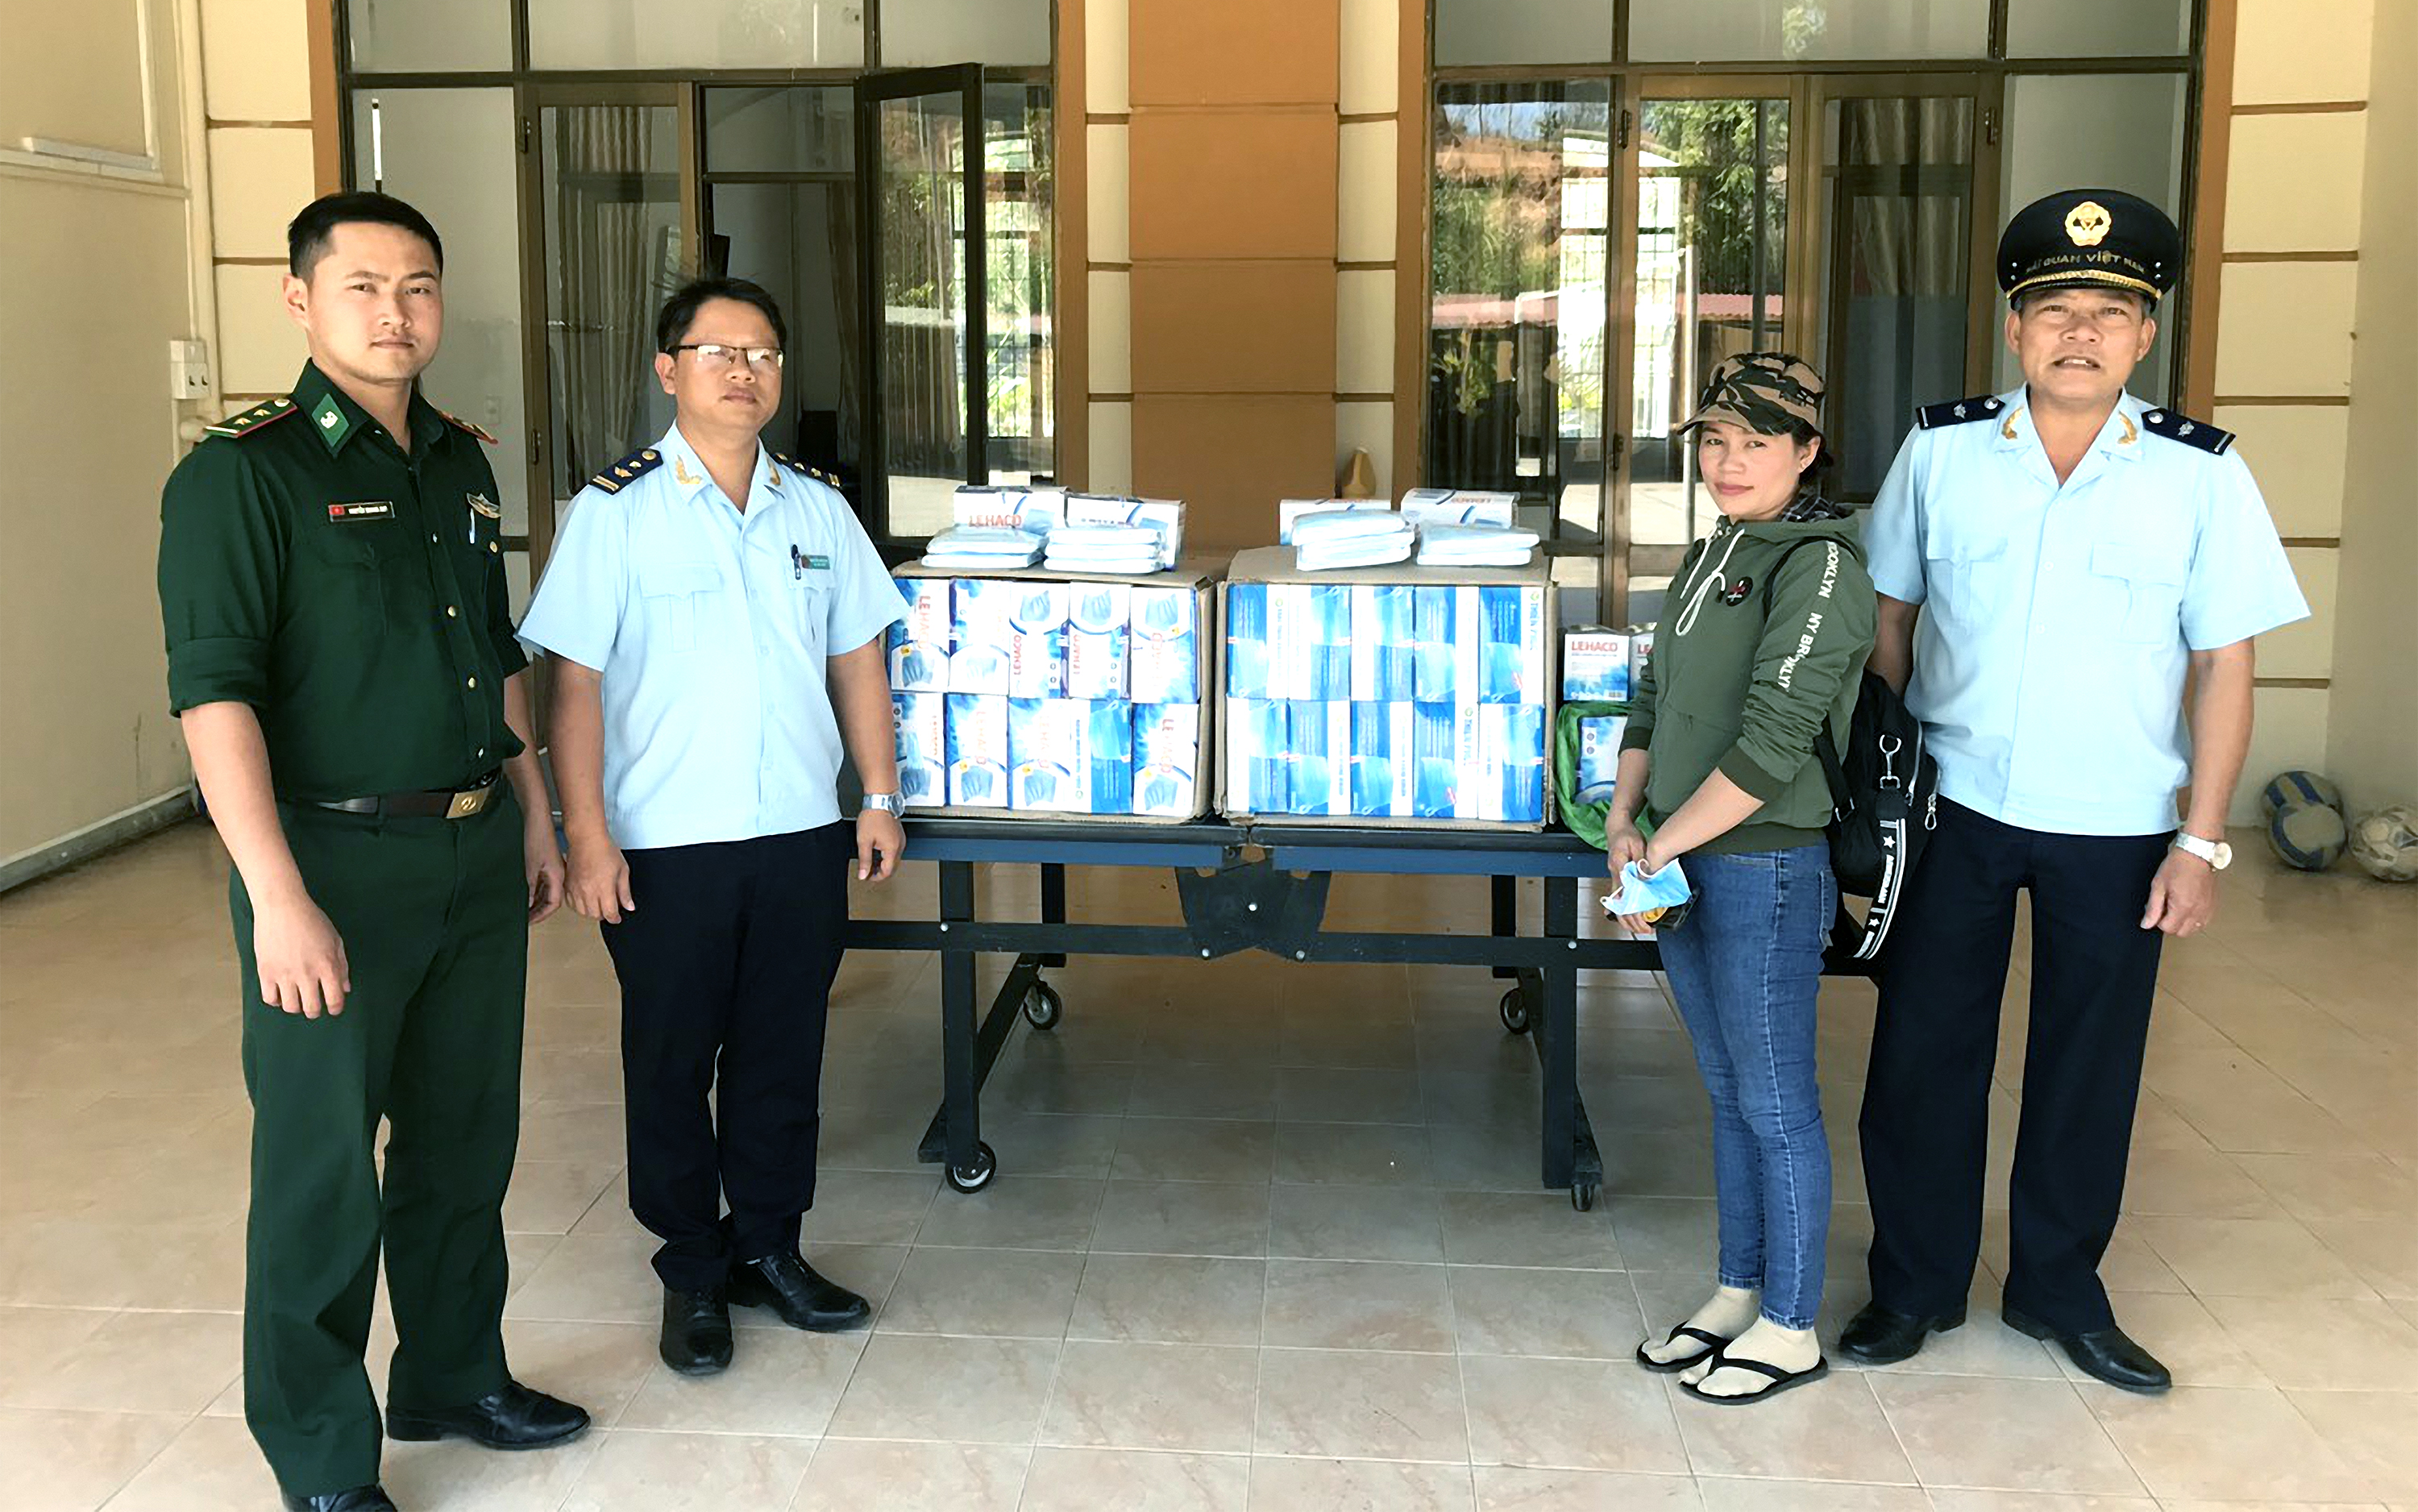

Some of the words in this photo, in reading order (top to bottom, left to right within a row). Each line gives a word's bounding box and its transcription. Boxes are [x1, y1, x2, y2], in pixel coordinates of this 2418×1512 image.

[2043, 255, 2081, 267] QUAN
[968, 514, 1022, 527] LEHACO
[919, 596, 931, 650] LEHACO
[1571, 641, 1618, 652] LEHACO
[975, 711, 987, 766] LEHAO
[1037, 715, 1050, 769] LEHAO
